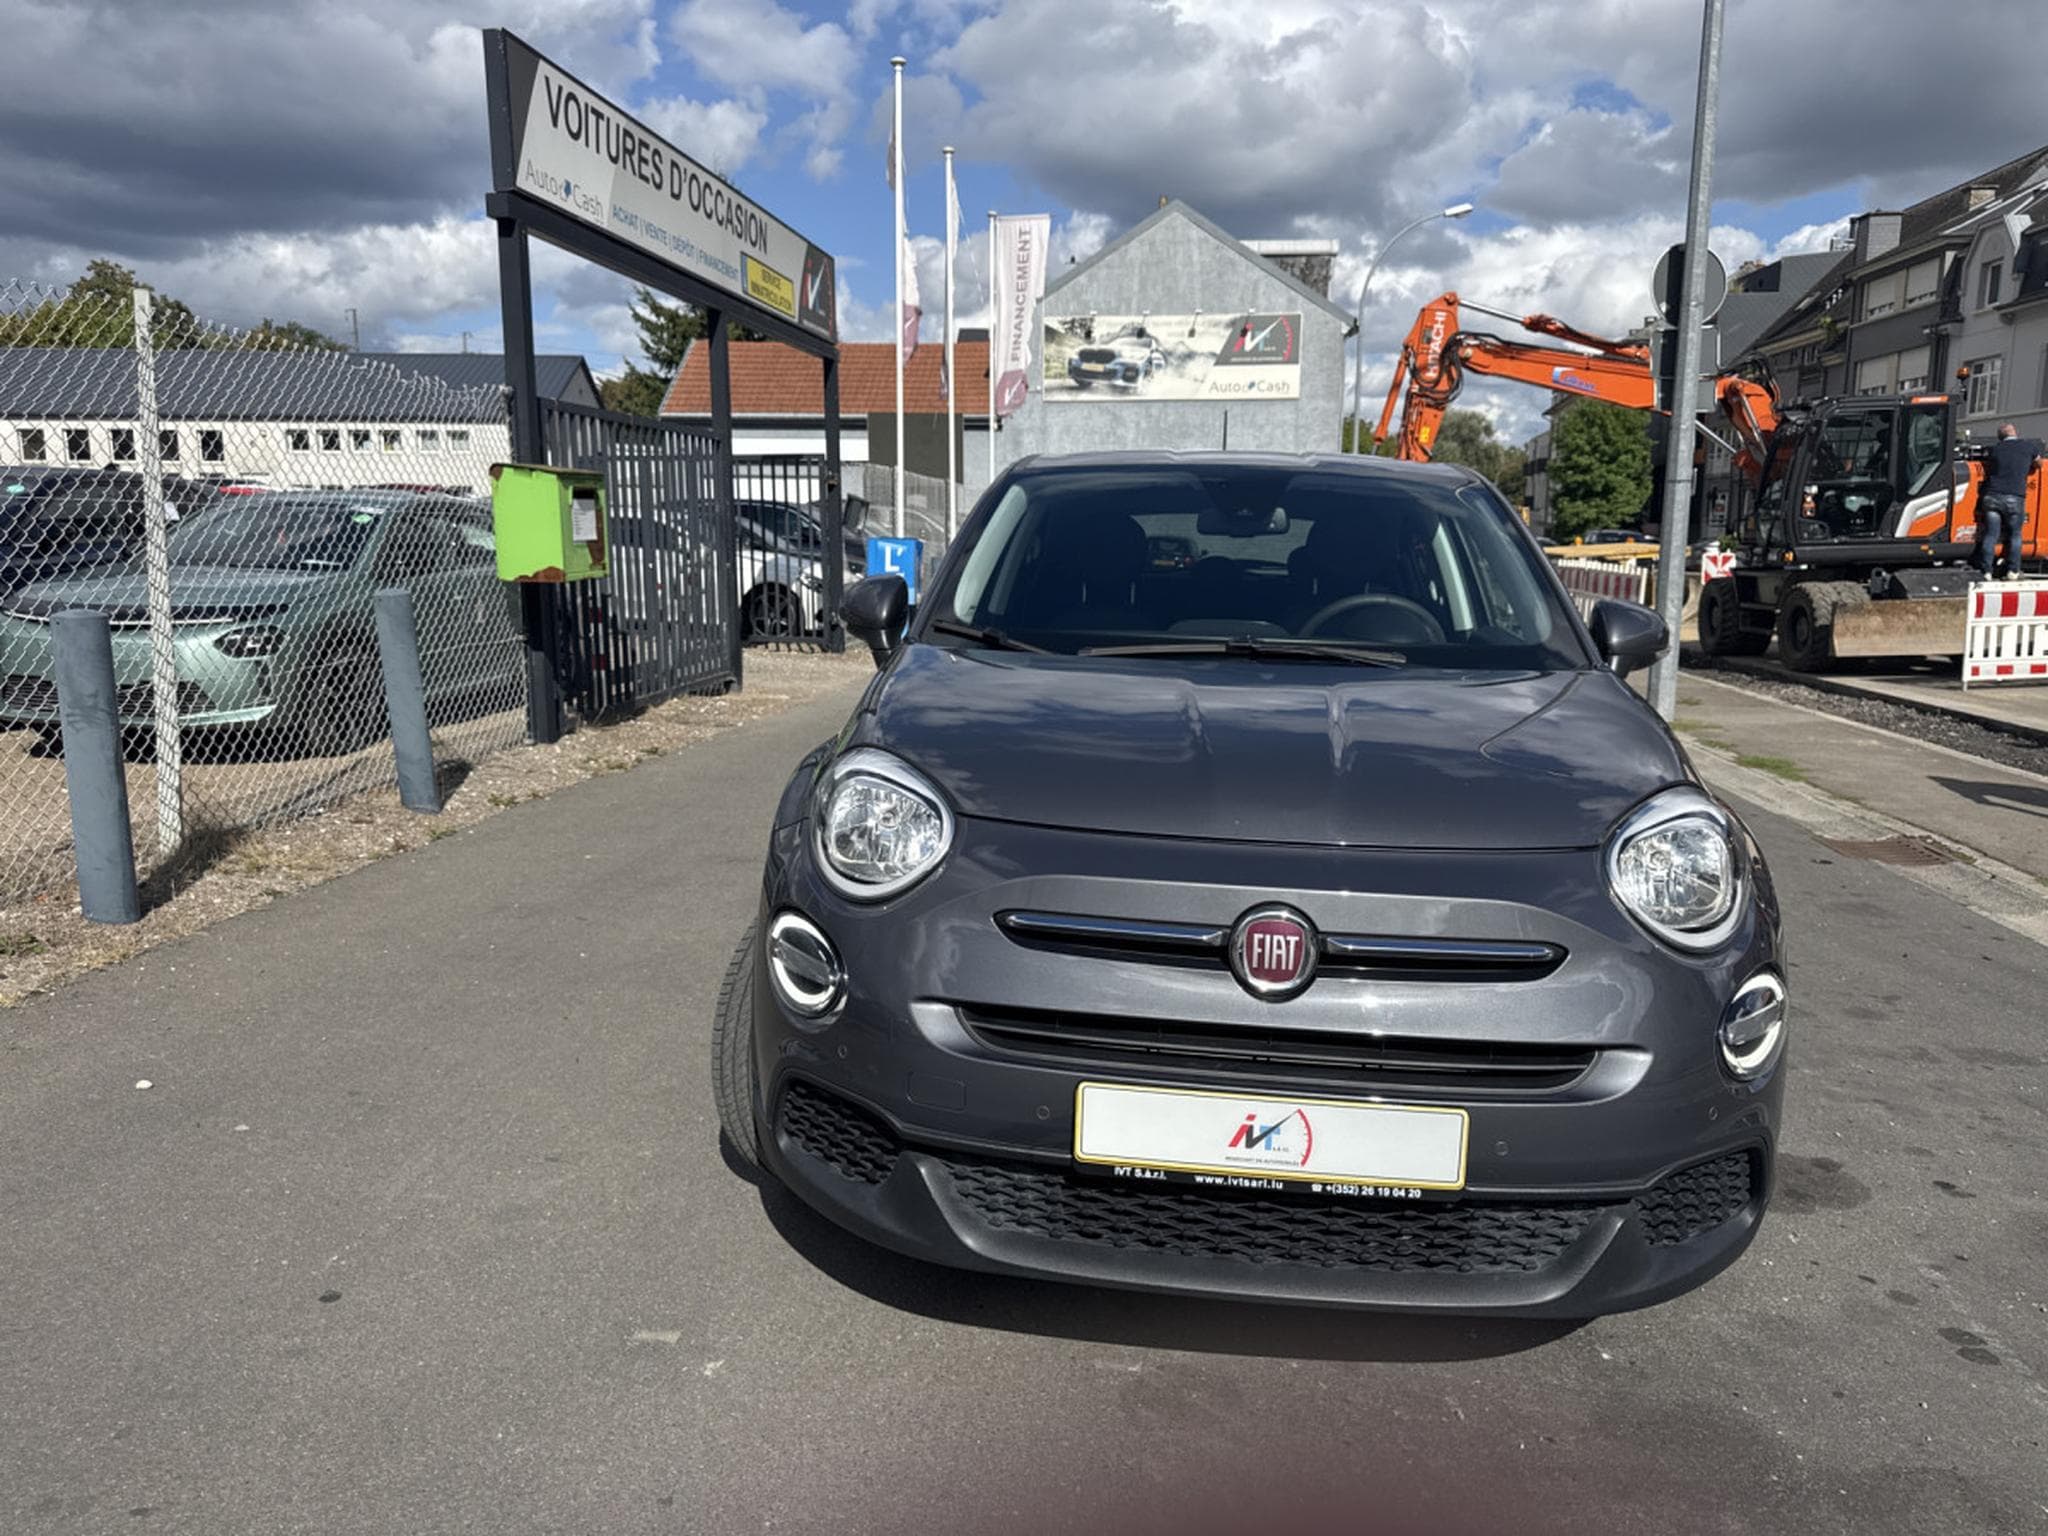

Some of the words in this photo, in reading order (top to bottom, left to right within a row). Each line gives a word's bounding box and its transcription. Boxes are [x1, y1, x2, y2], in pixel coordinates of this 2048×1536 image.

[545, 76, 664, 191] VOITURES
[670, 159, 768, 255] D'OCCASION
[573, 184, 605, 219] Cash
[613, 204, 639, 232] ACHAT
[644, 220, 668, 247] VENTE
[1011, 226, 1032, 363] FINANCEMENT
[1425, 311, 1448, 377] HITACHI
[1257, 380, 1291, 393] Cash
[1252, 932, 1300, 971] FIAT
[1114, 1166, 1132, 1177] IVT
[1194, 1175, 1284, 1190] www.ivtsarl.lu
[1361, 1185, 1375, 1196] 26
[1377, 1187, 1391, 1197] 19
[1392, 1187, 1406, 1198] 04
[1407, 1188, 1422, 1199] 20
